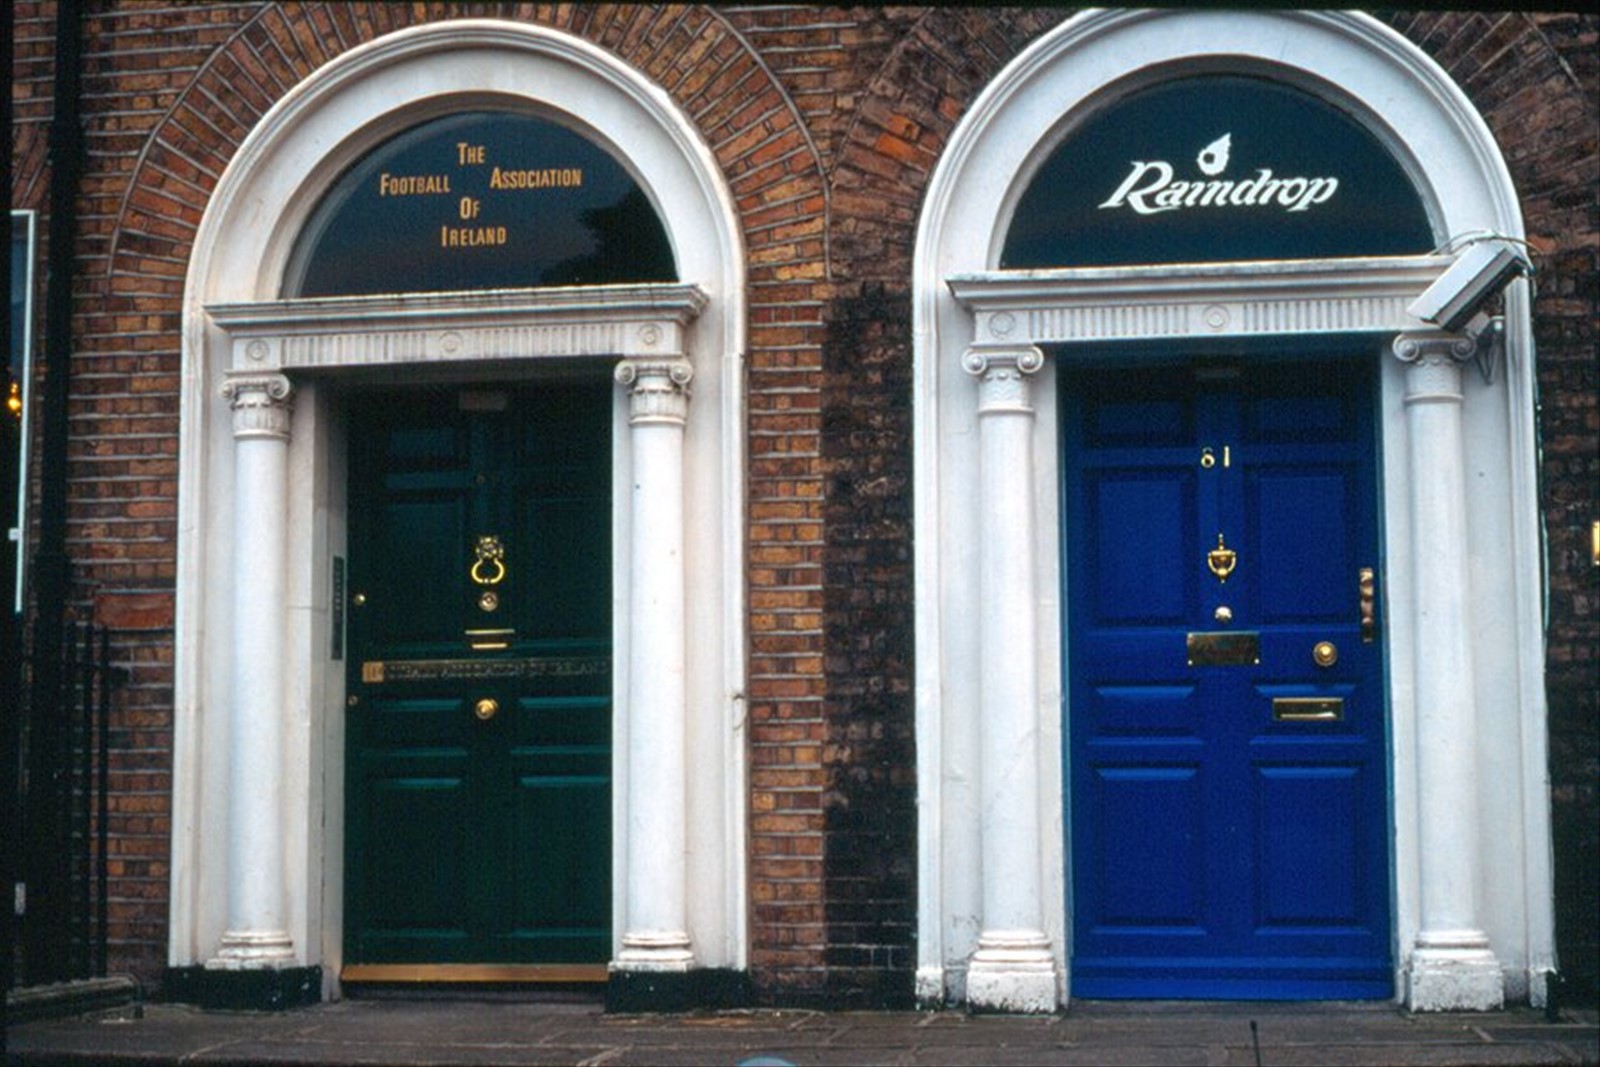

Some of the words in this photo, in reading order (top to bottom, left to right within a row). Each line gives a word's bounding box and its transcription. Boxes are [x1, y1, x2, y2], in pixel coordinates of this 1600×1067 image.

[457, 142, 485, 165] THE
[380, 173, 450, 196] FOOTBALL
[490, 167, 582, 189] ASSOCIATION
[1098, 160, 1339, 215] Raindrop
[459, 197, 480, 219] OF
[440, 225, 507, 247] IRELAND
